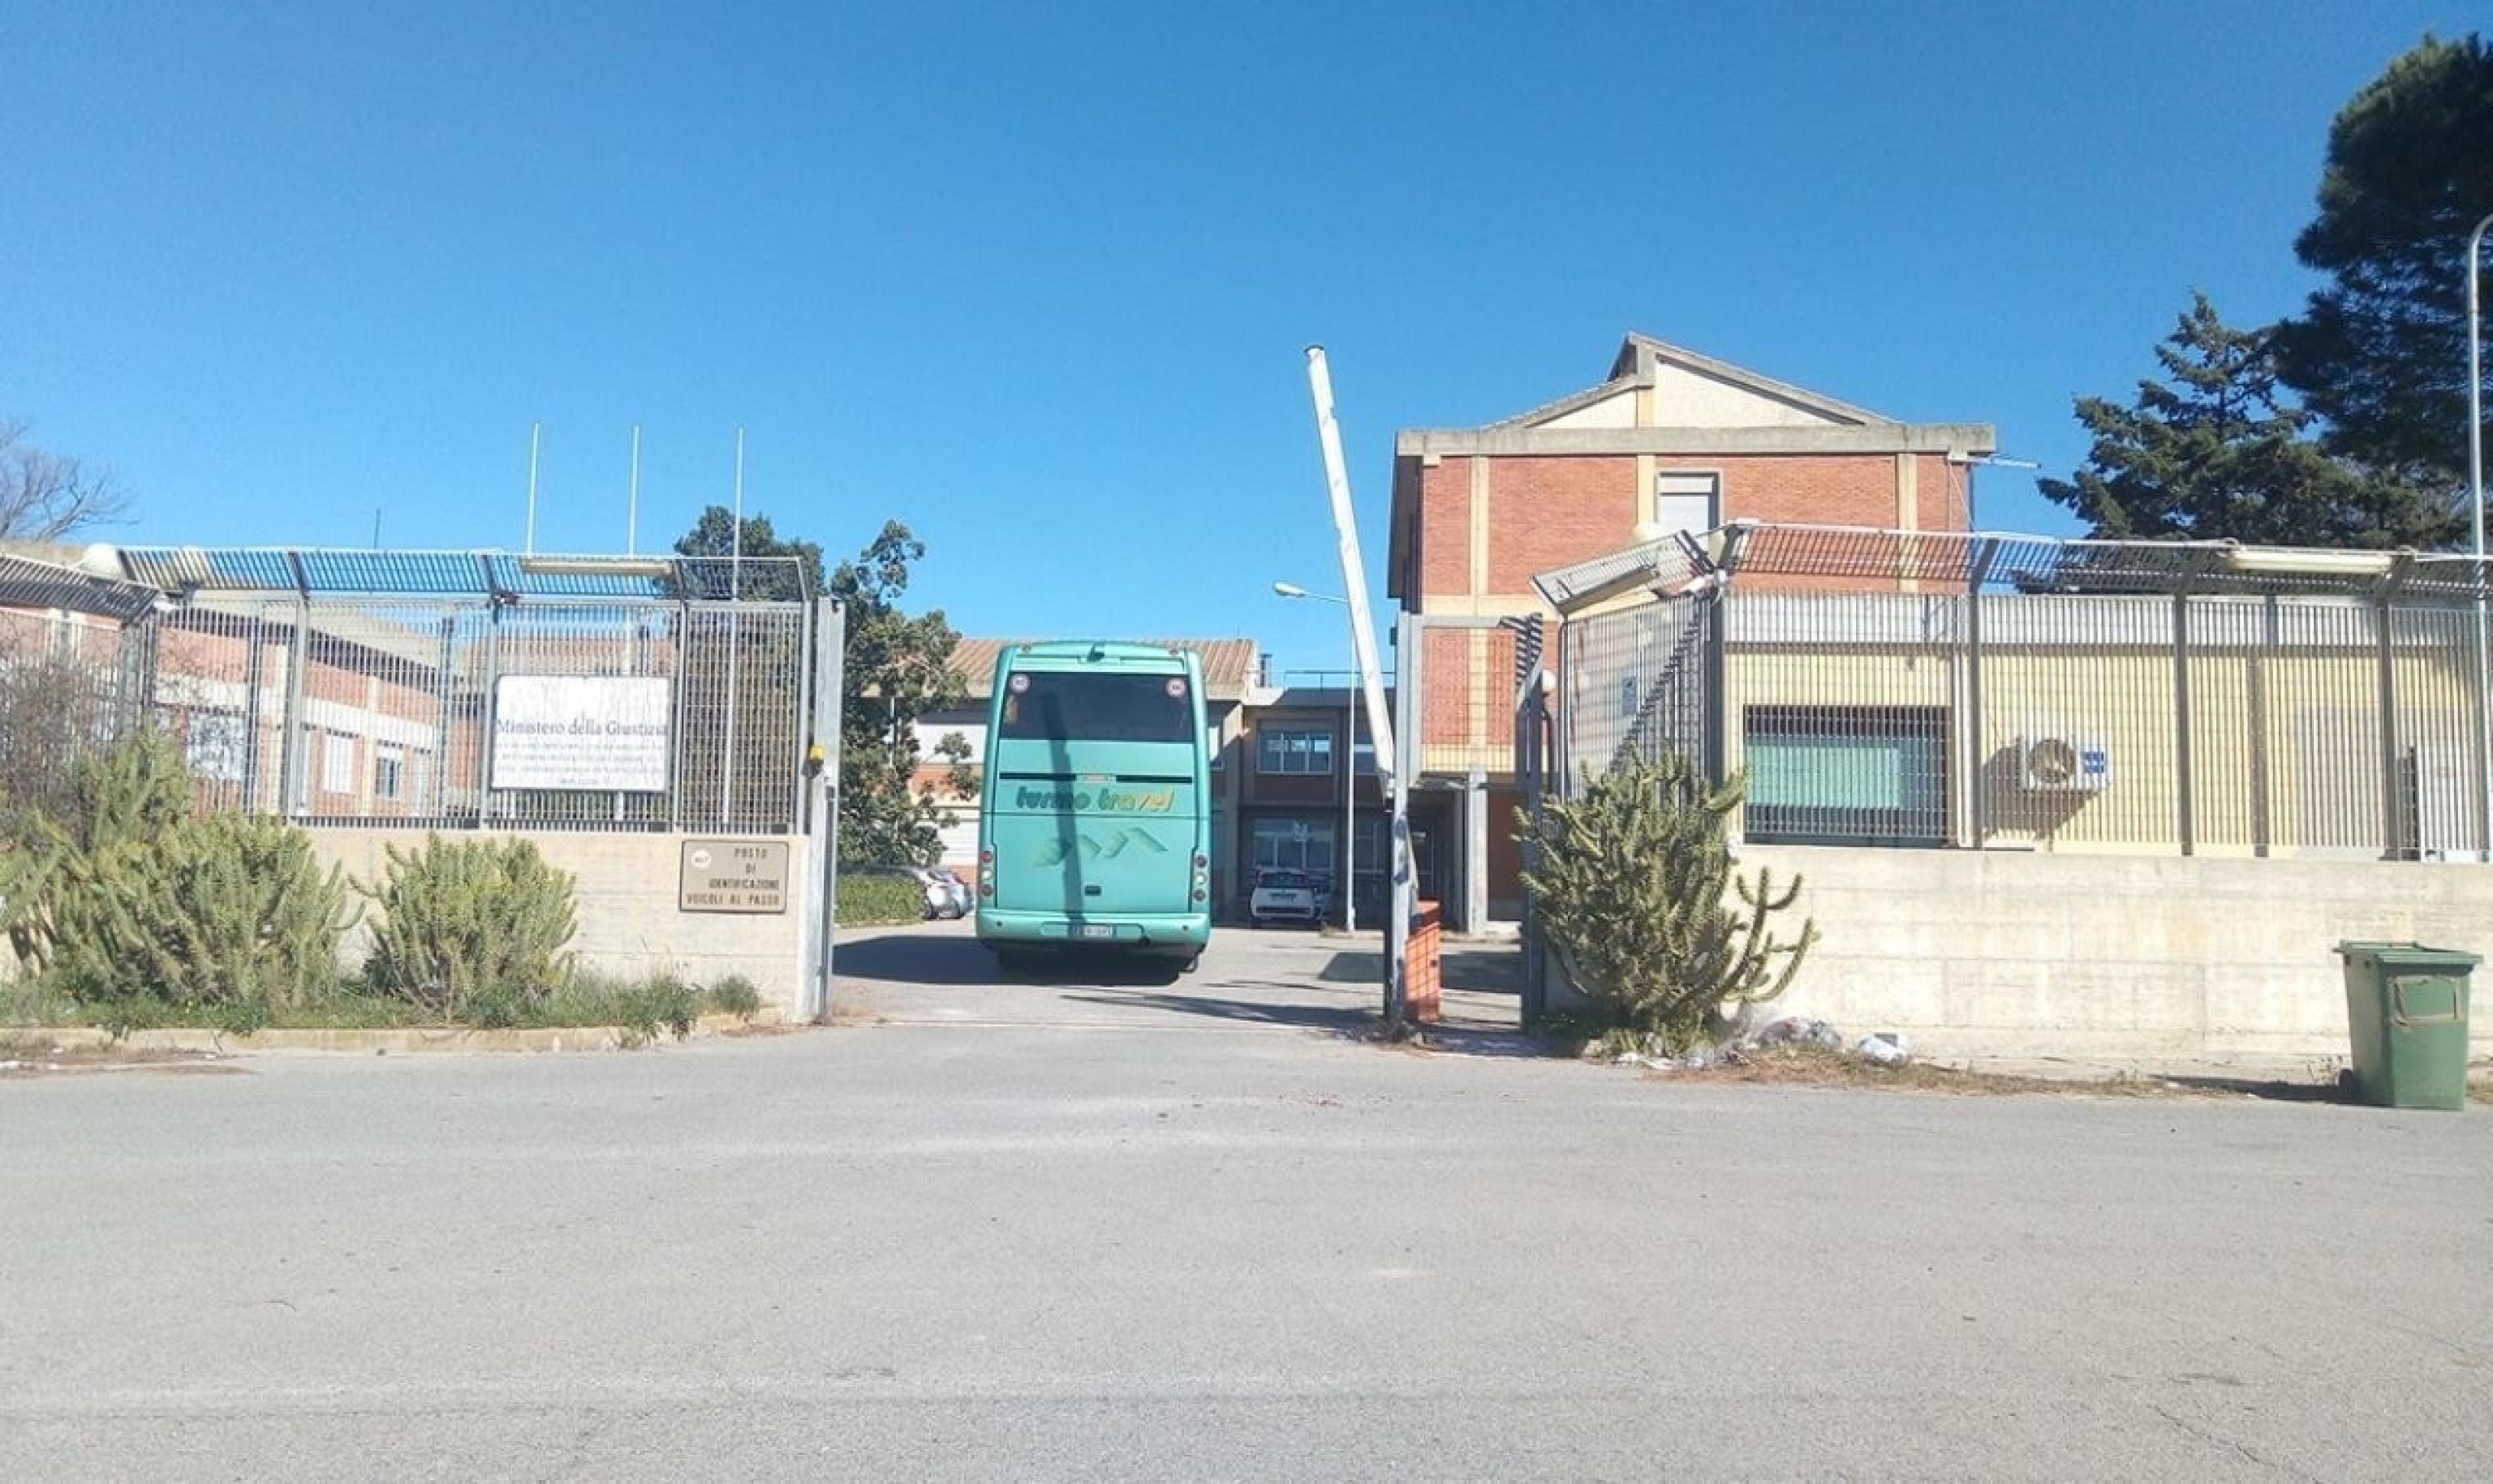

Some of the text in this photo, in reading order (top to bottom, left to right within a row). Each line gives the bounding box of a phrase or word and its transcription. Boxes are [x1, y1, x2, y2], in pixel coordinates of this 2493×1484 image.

[497, 717, 668, 736] Ministero della Giustizia
[1098, 788, 1175, 812] travel
[734, 847, 767, 858] POSTO
[746, 862, 756, 874] DI
[730, 893, 741, 904] AL
[749, 893, 780, 905] PASSO
